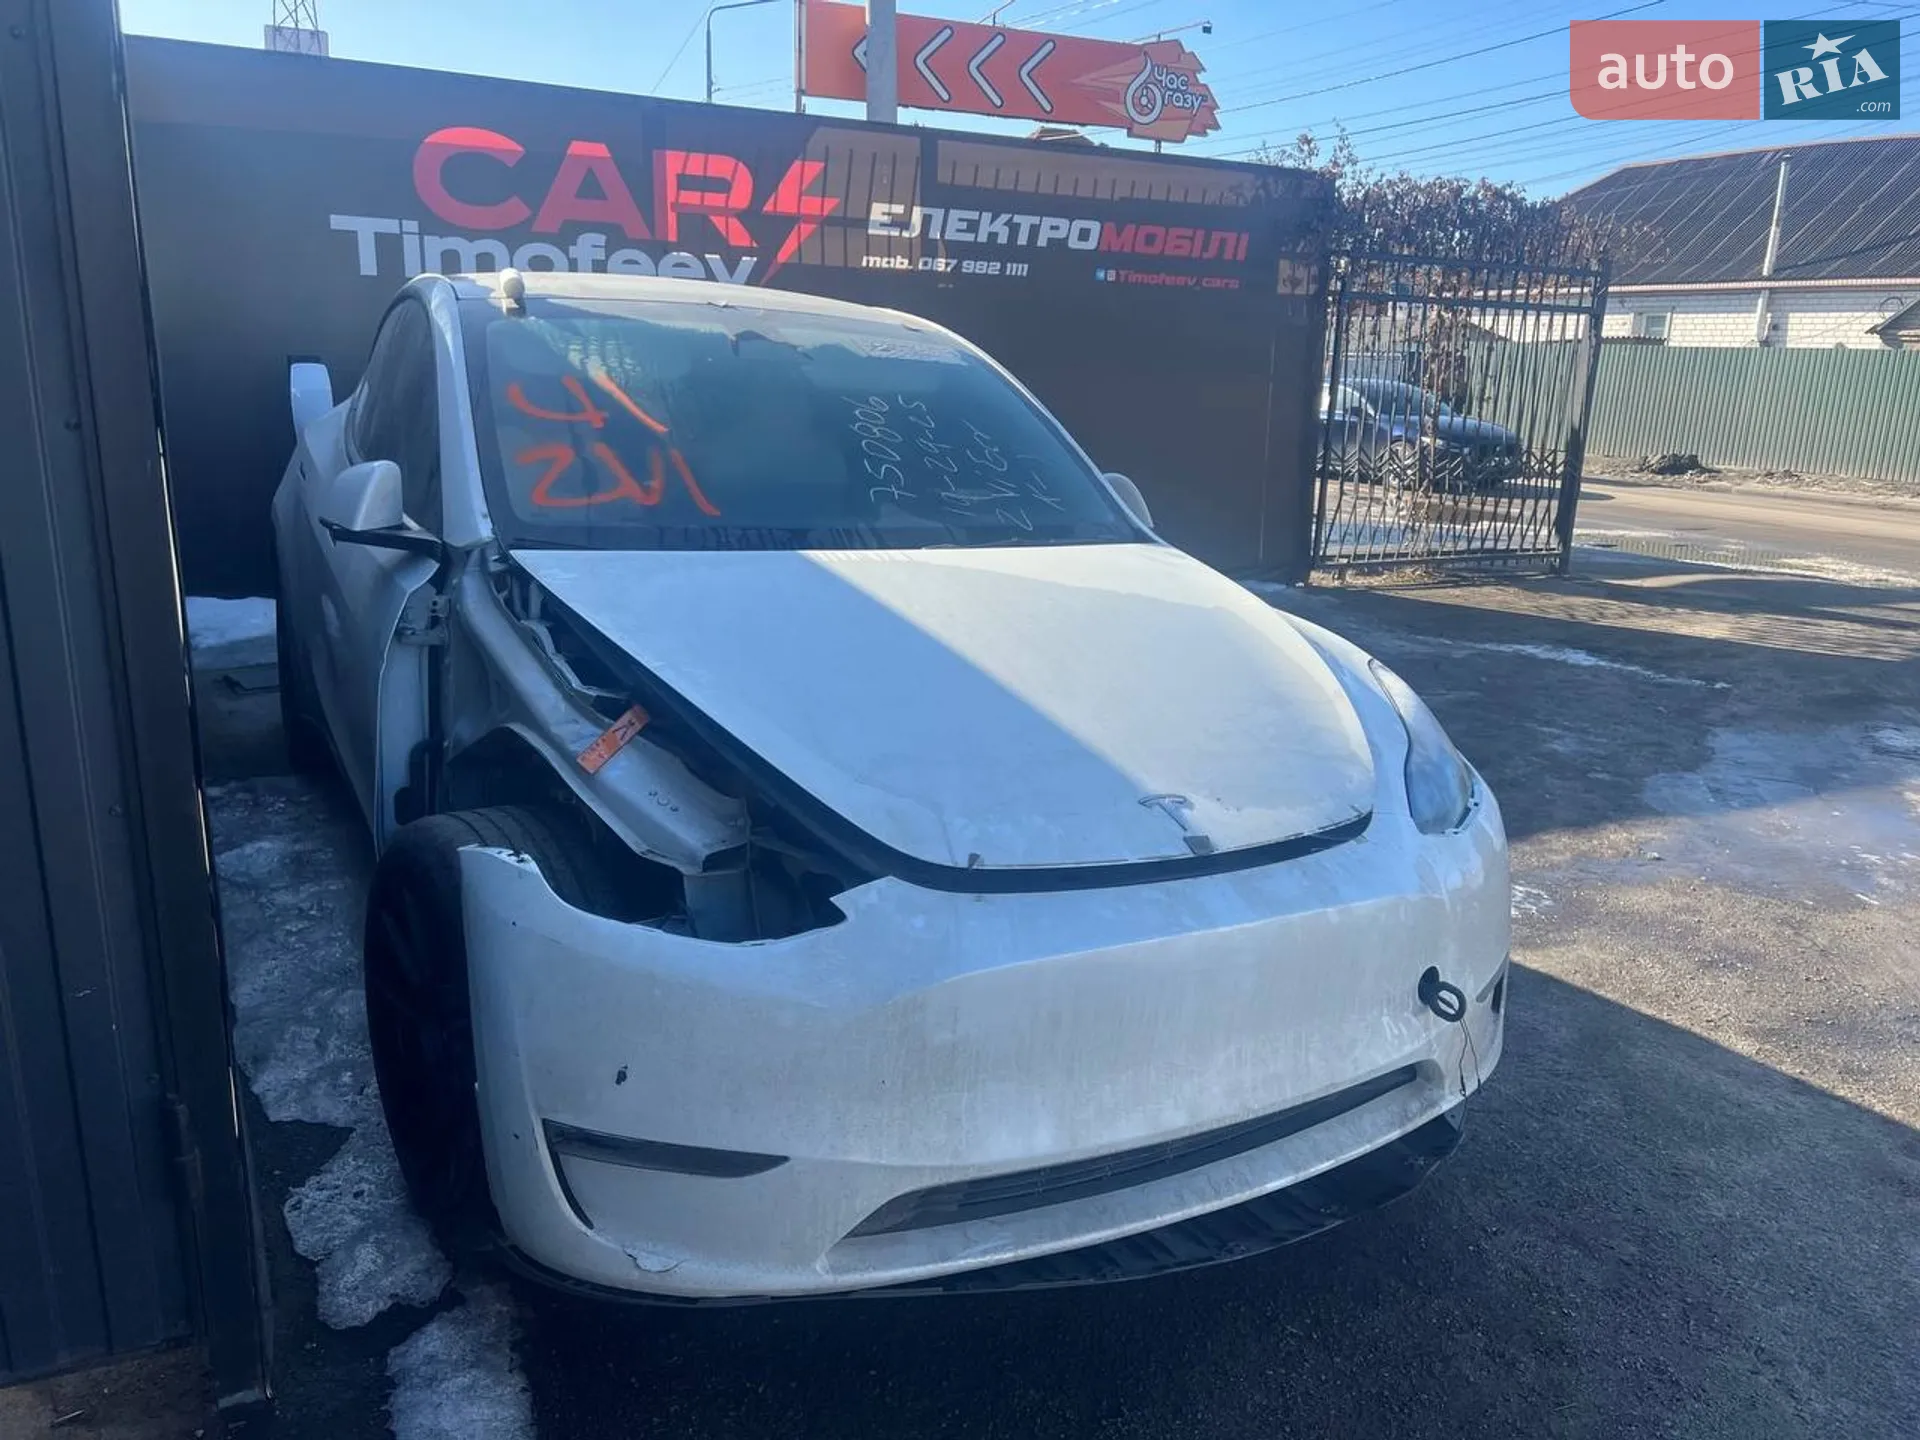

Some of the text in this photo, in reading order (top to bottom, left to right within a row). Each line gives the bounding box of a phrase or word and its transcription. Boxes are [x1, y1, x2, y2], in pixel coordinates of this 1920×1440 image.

[1154, 65, 1188, 89] Час
[329, 214, 758, 285] Timofeev
[961, 260, 1001, 275] 982
